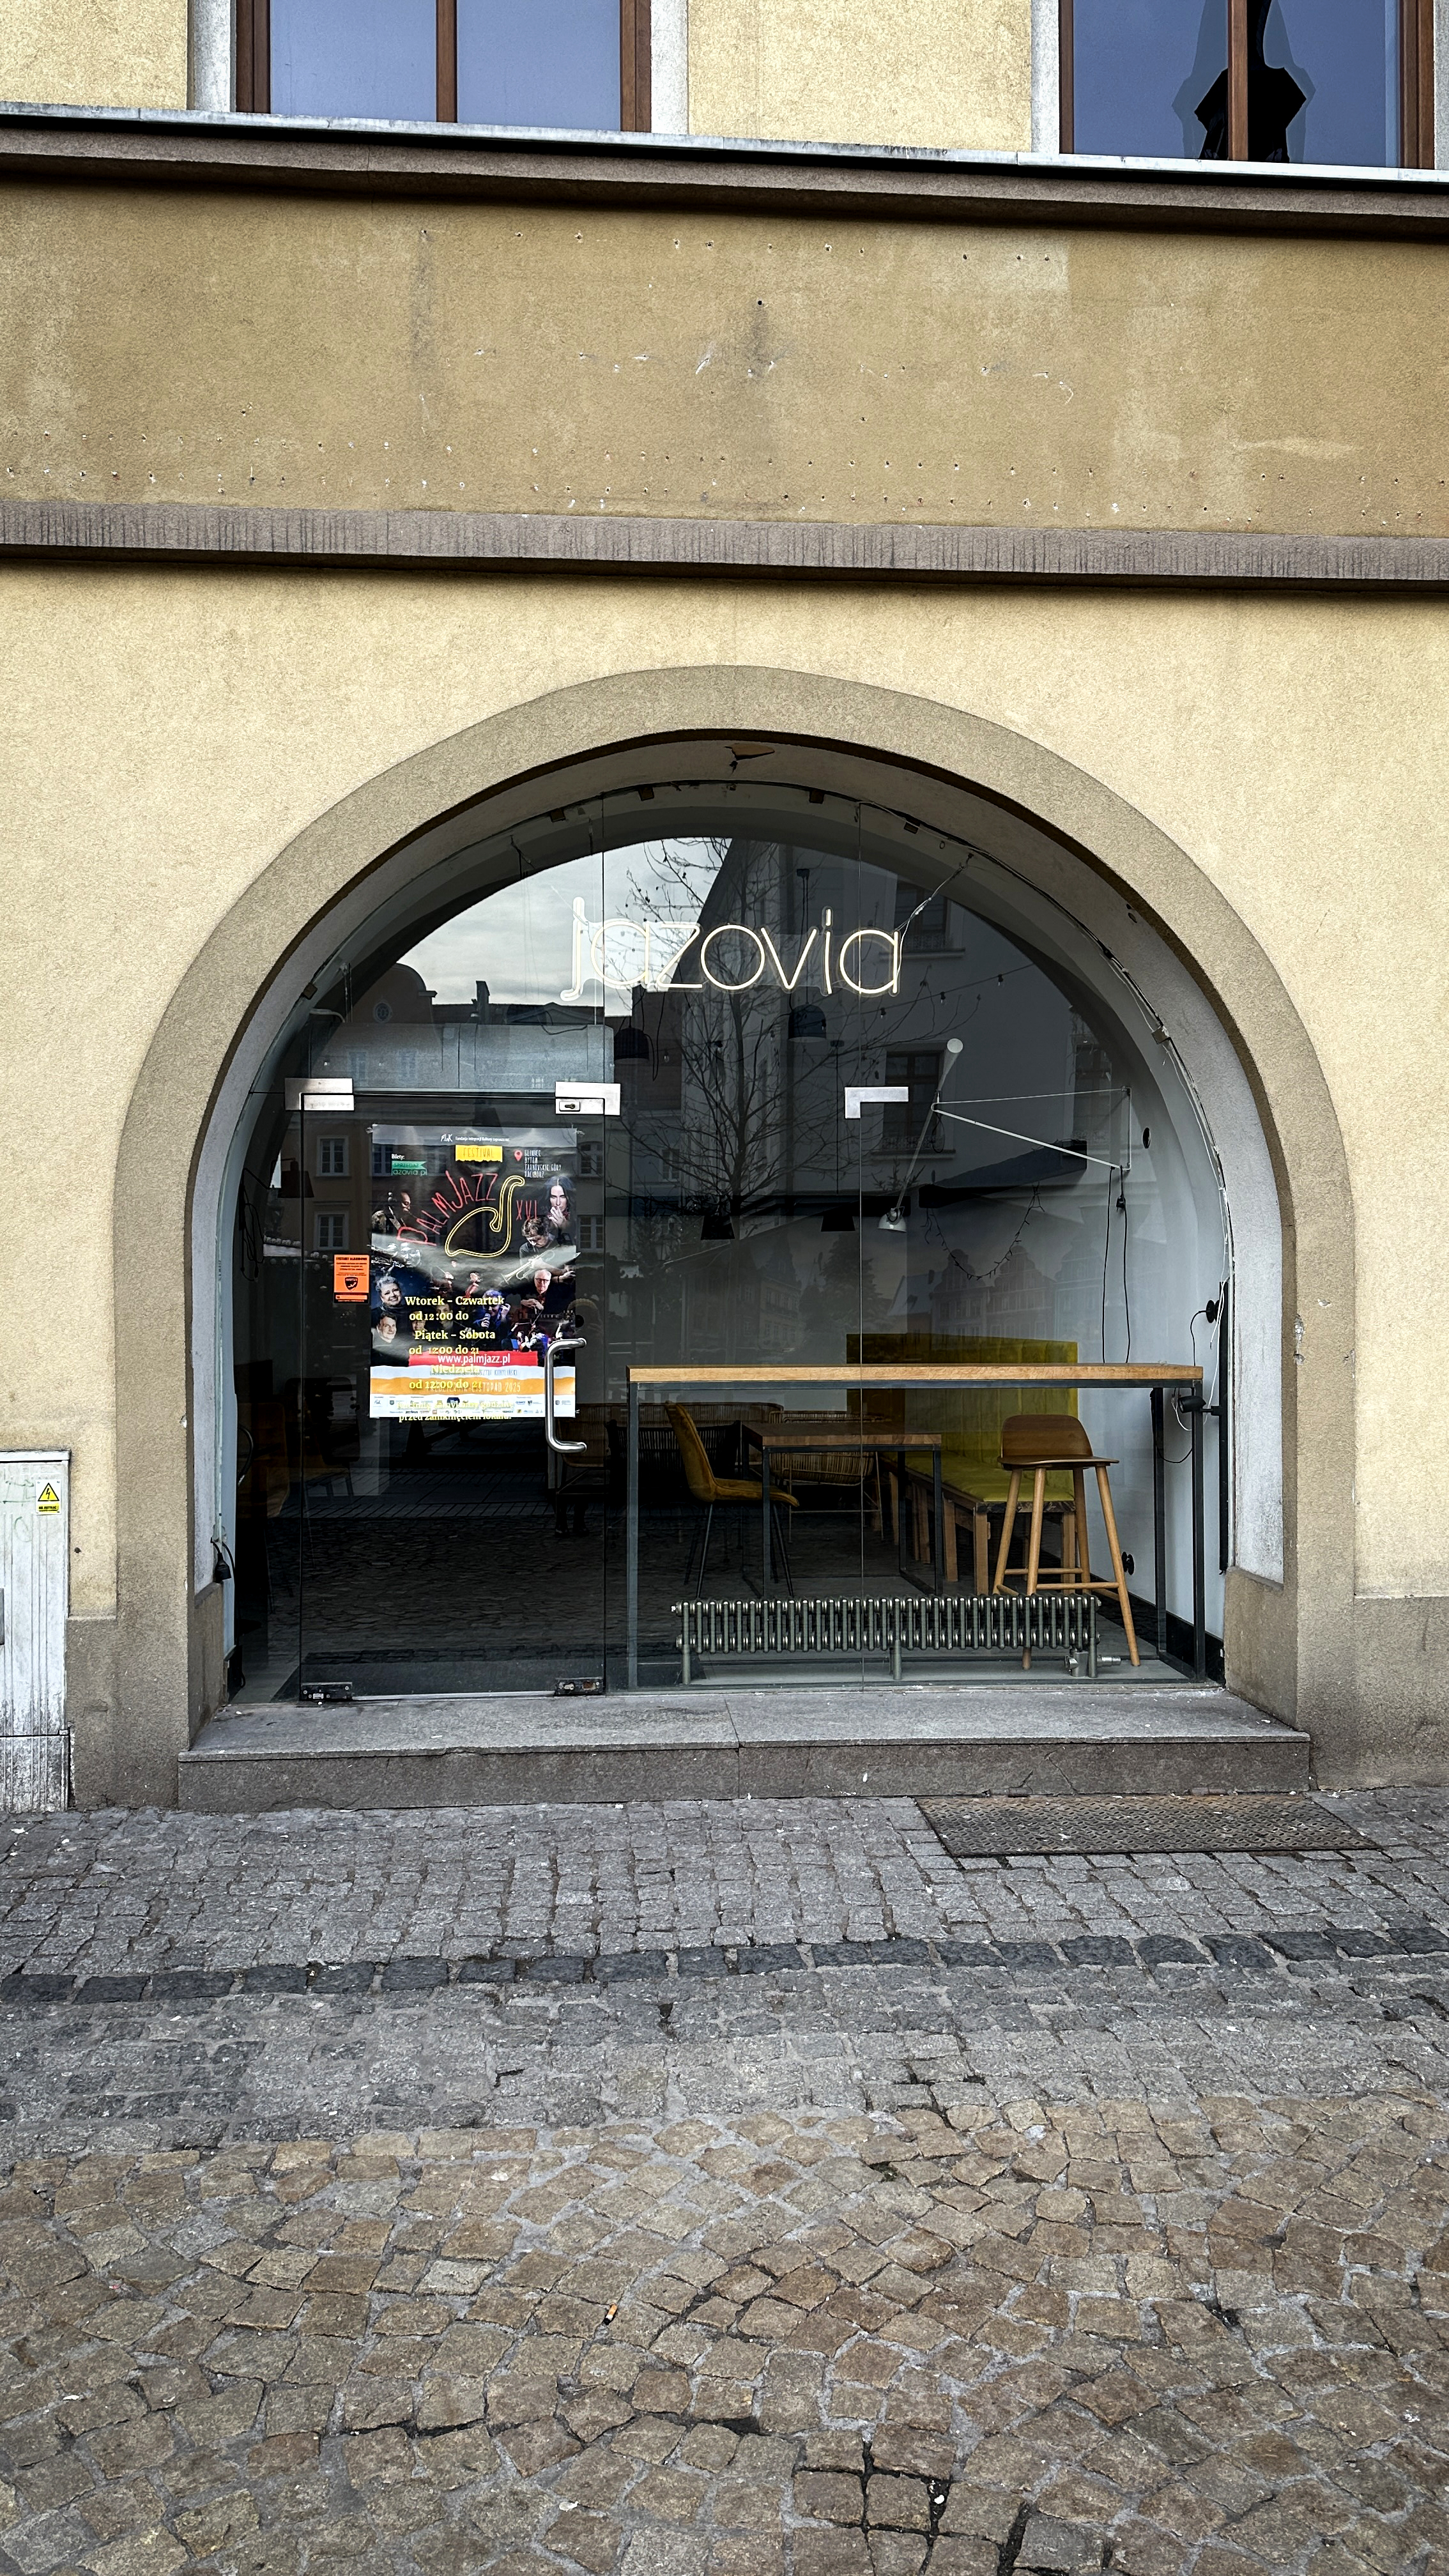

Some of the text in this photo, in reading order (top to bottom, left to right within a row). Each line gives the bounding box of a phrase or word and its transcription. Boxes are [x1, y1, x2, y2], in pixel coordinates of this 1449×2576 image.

[560, 897, 901, 1000] jazovia
[463, 1147, 494, 1158] FESTIVAL
[404, 1296, 445, 1305] Wtorek
[456, 1296, 504, 1305] Czwartek
[409, 1311, 422, 1321] od
[456, 1311, 469, 1321] do
[415, 1330, 448, 1341] Piątek
[459, 1330, 496, 1339] Sobota
[409, 1346, 422, 1354] od
[456, 1345, 468, 1354] do
[438, 1353, 510, 1365] www.palmjazz.pl
[409, 1380, 422, 1389] od
[456, 1379, 469, 1389] do
[505, 1382, 521, 1392] 2025
